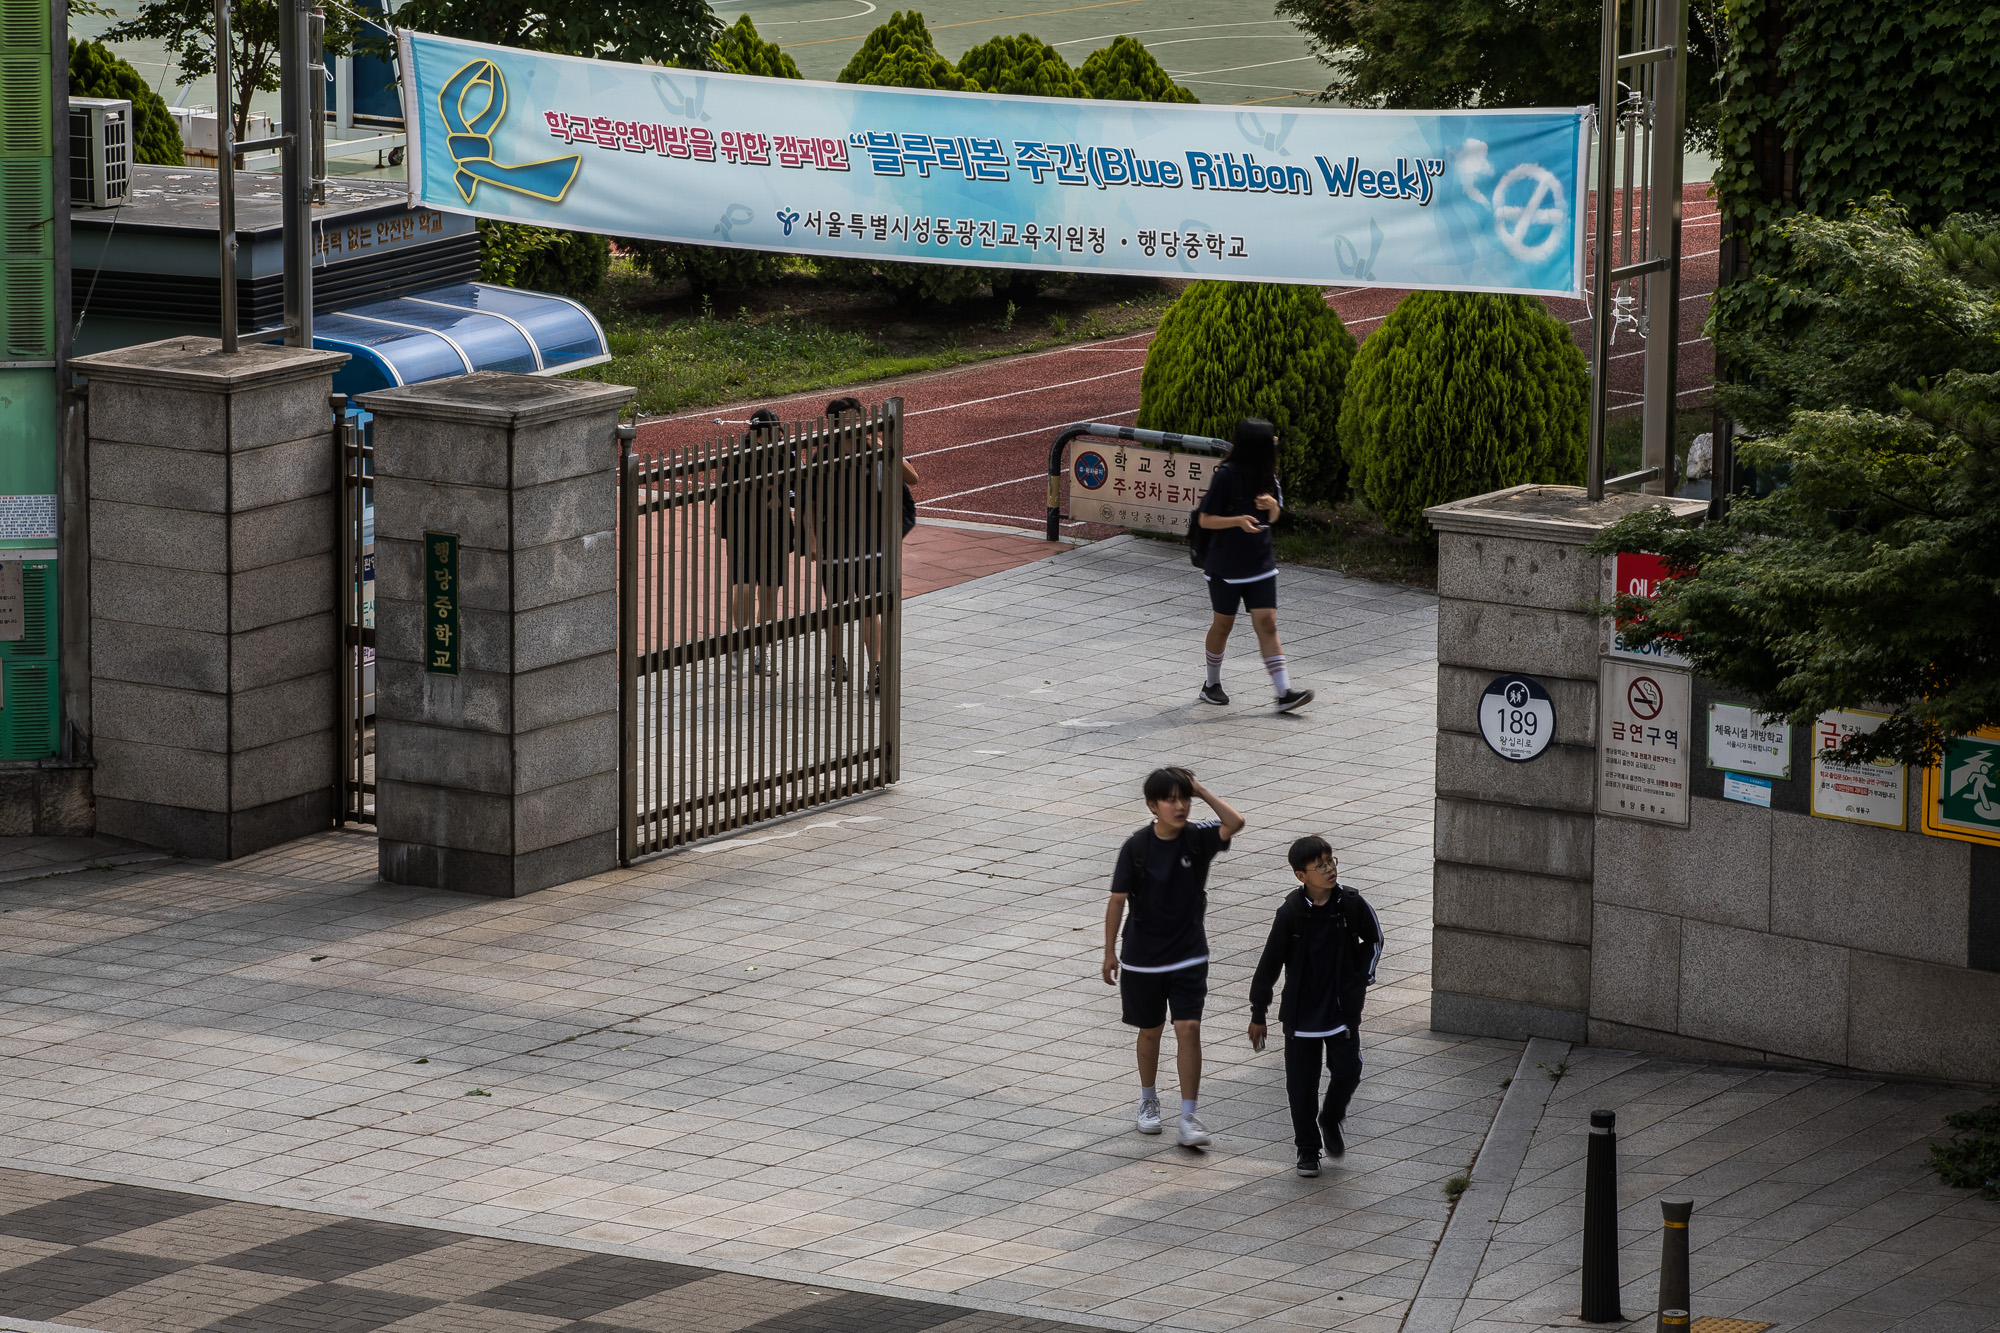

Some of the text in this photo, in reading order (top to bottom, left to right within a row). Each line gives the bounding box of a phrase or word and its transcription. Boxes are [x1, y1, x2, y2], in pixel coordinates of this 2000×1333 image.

[543, 110, 715, 162] 학교흡연예방을
[720, 130, 770, 166] 위한
[773, 134, 851, 171] 캠페인
[1185, 150, 1311, 195] Ribbon
[347, 226, 372, 251] 없는
[377, 216, 415, 244] 안전한
[418, 210, 443, 235] 학교
[1137, 229, 1249, 261] 행당중학교
[1497, 708, 1538, 736] 189
[1611, 721, 1678, 750] 금연구역
[1715, 724, 1784, 744] 체육시설 개방학교
[1499, 736, 1532, 748] 왕십리로
[1726, 740, 1773, 754] 서울시가 지원합니다
